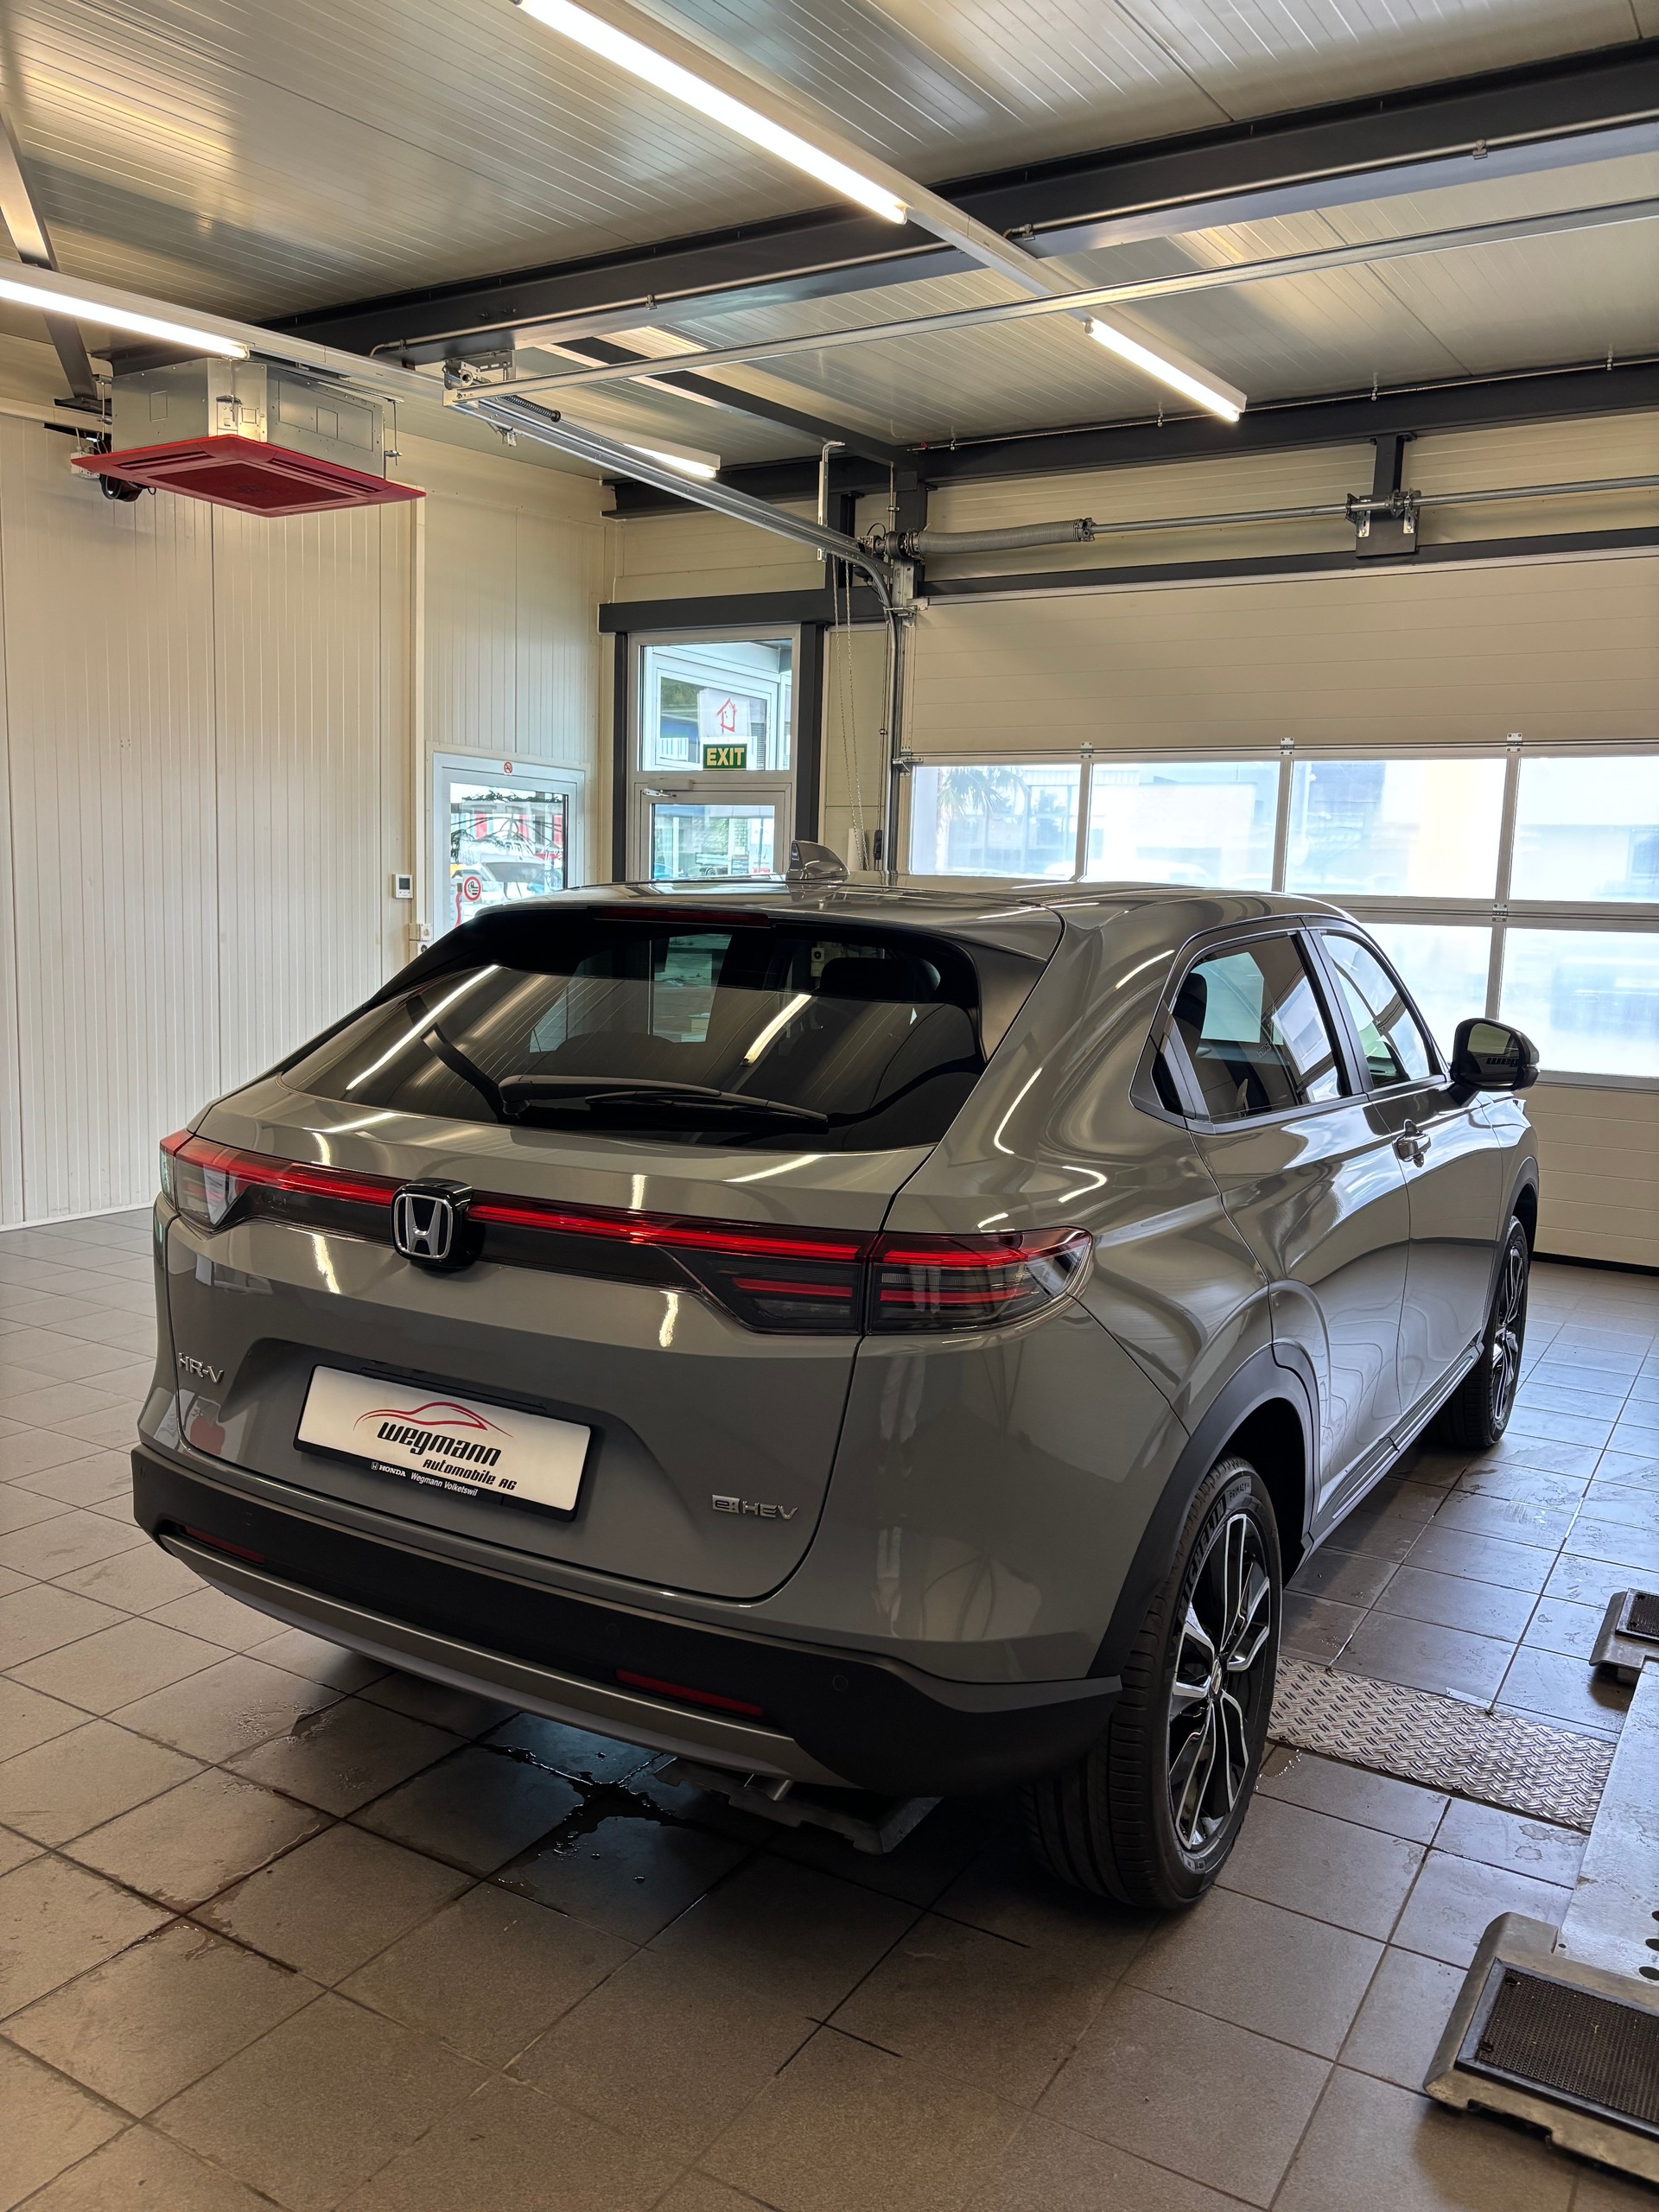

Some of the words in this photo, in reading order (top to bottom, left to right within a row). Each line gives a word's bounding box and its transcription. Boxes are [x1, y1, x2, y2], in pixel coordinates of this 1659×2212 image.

[706, 747, 746, 766] EXIT
[178, 1352, 224, 1383] HR-V
[377, 1421, 502, 1467] wegmann
[378, 1464, 407, 1477] HONDA
[410, 1471, 443, 1488] Wegmann
[443, 1481, 479, 1497] Volketswil
[422, 1459, 496, 1485] Automobile
[499, 1477, 518, 1491] AG
[1177, 1497, 1227, 1624] MICHELIN
